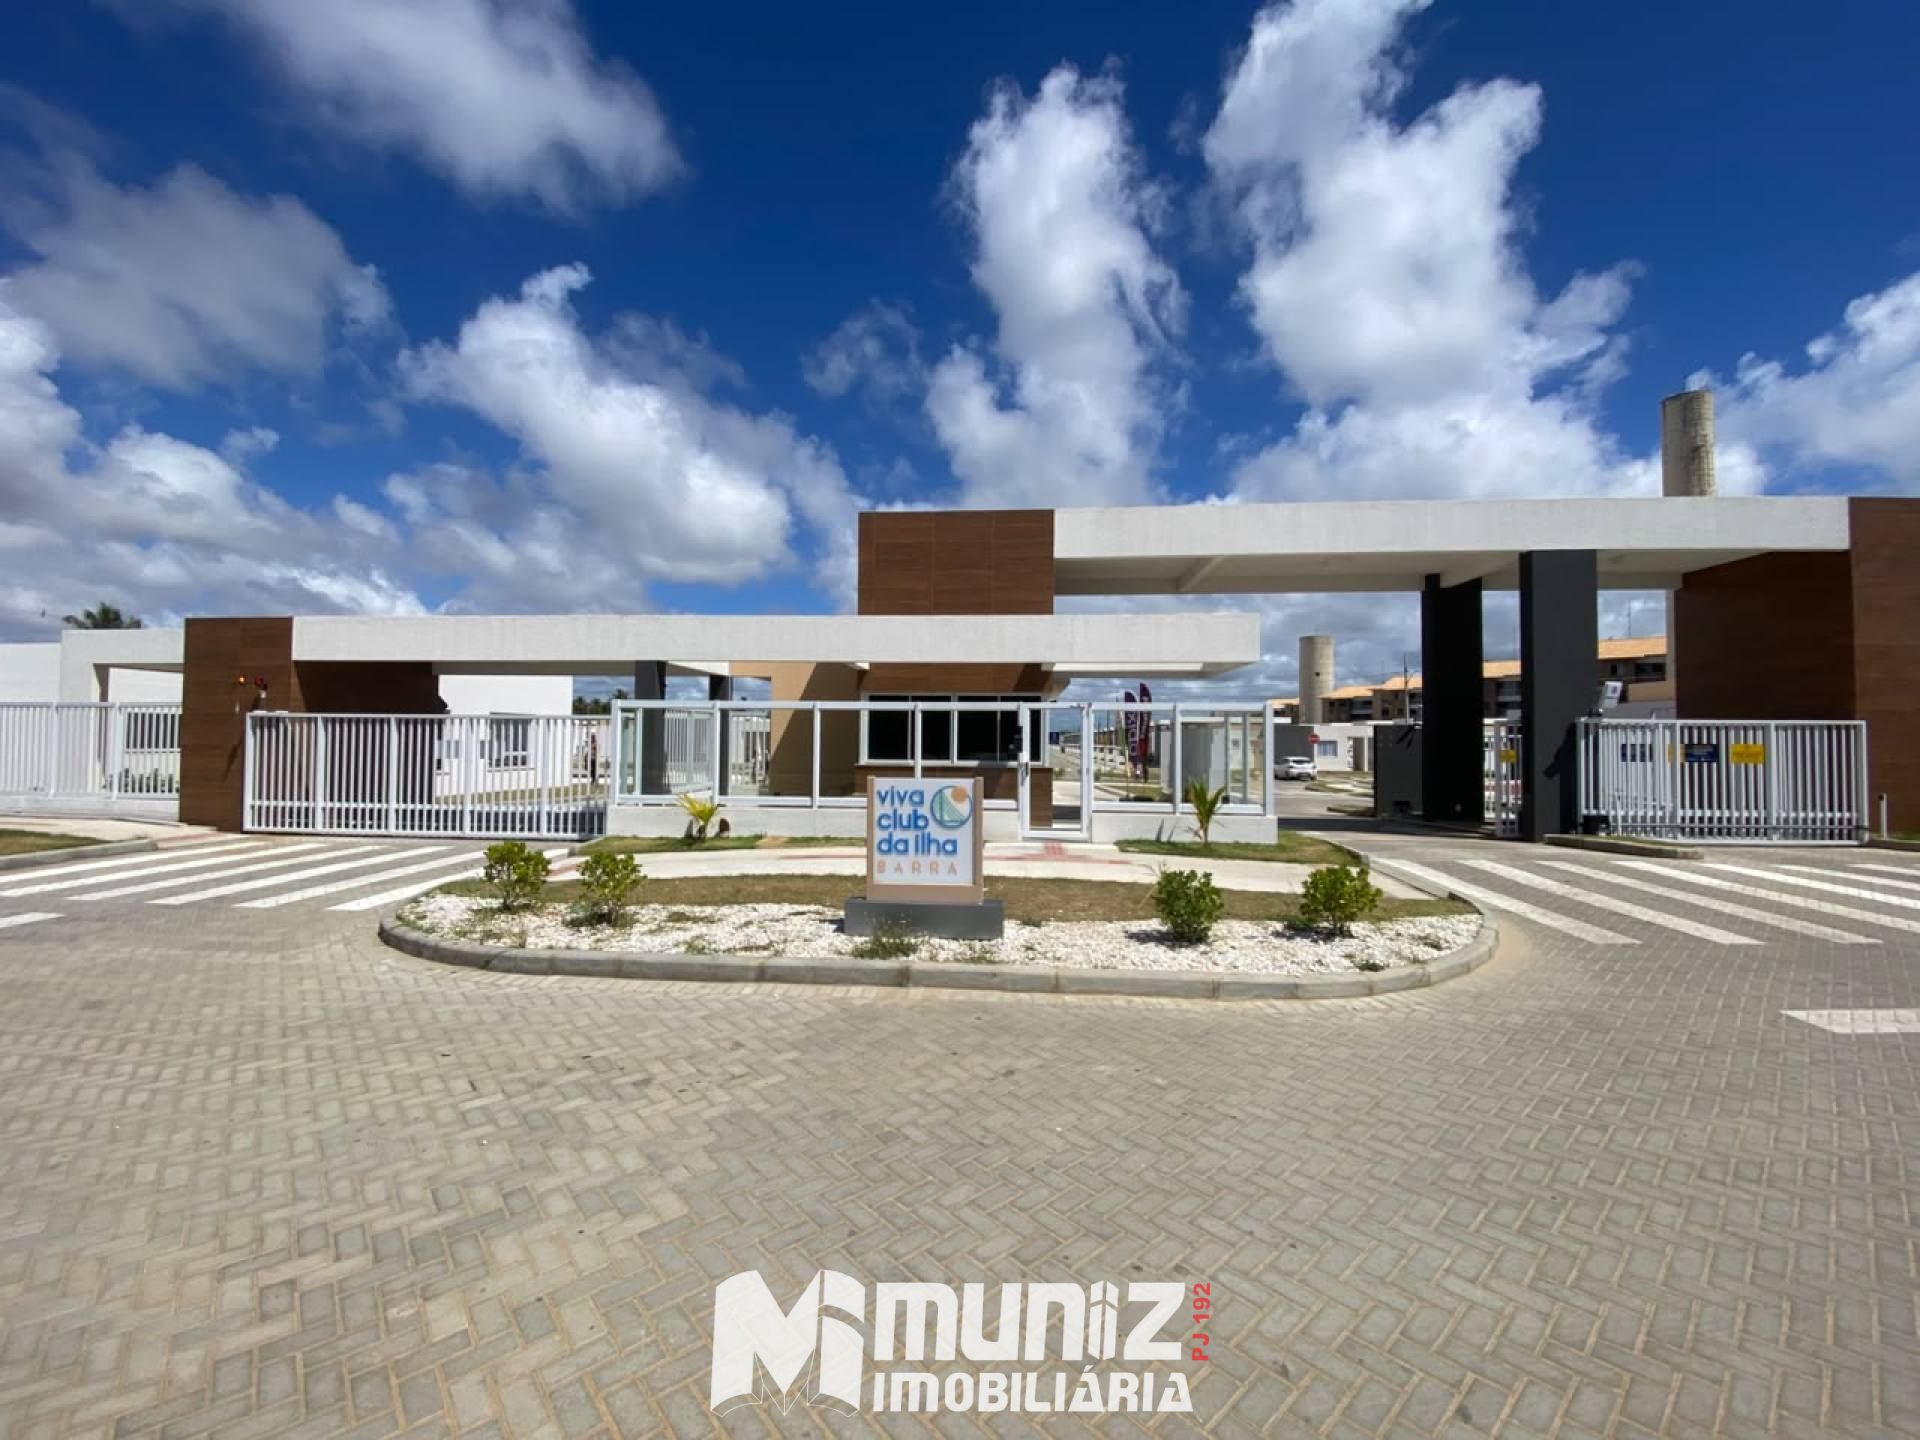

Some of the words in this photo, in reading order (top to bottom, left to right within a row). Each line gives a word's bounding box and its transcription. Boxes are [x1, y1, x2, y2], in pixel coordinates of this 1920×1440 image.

[876, 785, 925, 806] viva
[877, 808, 929, 830] club
[877, 831, 909, 855] da
[877, 860, 957, 875] BARRA
